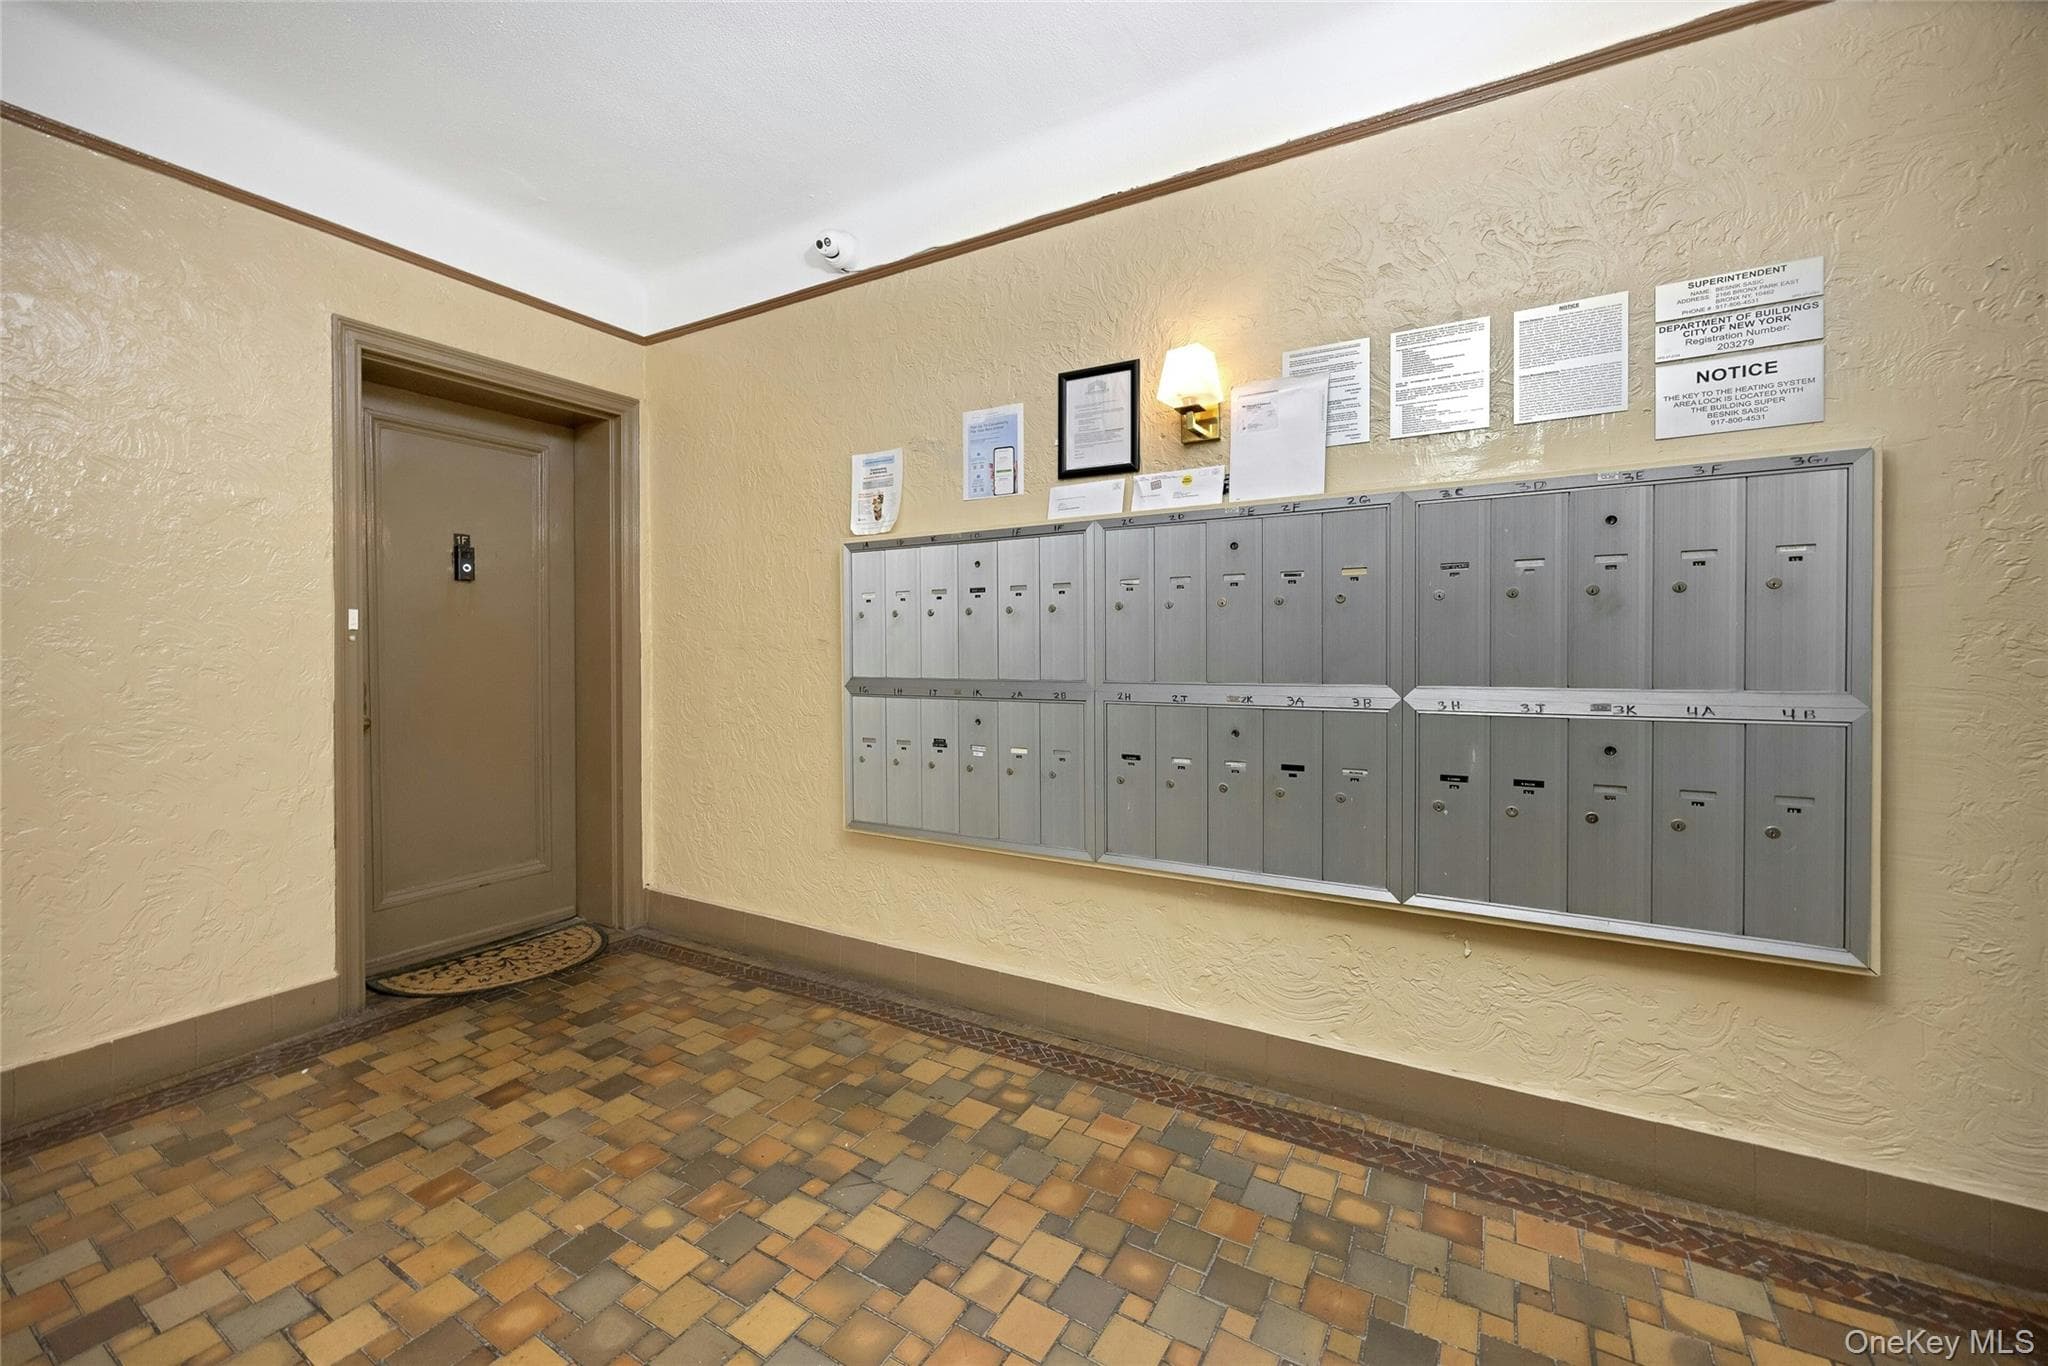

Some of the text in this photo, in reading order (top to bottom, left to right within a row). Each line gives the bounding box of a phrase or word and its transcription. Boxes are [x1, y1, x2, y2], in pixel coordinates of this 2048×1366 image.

[1687, 264, 1788, 290] SUPERINTENDENT
[1676, 294, 1709, 305] ADDRESS
[1732, 286, 1757, 295] BRONX
[1759, 282, 1778, 290] PARK
[1780, 278, 1799, 287] EAST
[1690, 279, 1764, 297] NAME BESNIK SASIC
[1715, 295, 1740, 304] BRONX
[1658, 301, 1819, 334] DEPARTMENT OF BUILDINGS
[1681, 307, 1705, 316] PHONE
[1682, 314, 1792, 338] CITY OF NEW YORK
[1685, 324, 1790, 347] Registration Number:
[1717, 338, 1755, 351] 203279
[1696, 360, 1779, 384] NOTICE
[1663, 376, 1816, 402] THE KEY TO THE HEATING SYSTEM
[1673, 385, 1804, 408] AREA LOCK IS LOCATED WITH
[1691, 396, 1786, 414] THE BUILDING SUPER
[1707, 406, 1769, 419] BESNIK SASIC
[1692, 463, 1723, 476] 3F
[1622, 470, 1645, 482] 3E
[1439, 487, 1464, 498] 3C
[1346, 494, 1371, 505] 2G
[1281, 502, 1301, 513] 2F
[1121, 518, 1134, 526] 2C
[456, 535, 469, 545] 1F
[1011, 691, 1023, 699] 2A
[1053, 691, 1067, 700] 2B
[1117, 692, 1131, 701] 2H
[1240, 695, 1254, 704] 2K
[1286, 696, 1304, 708] 3A
[1352, 698, 1372, 708] 3B
[1437, 701, 1462, 711] 3H
[1613, 705, 1638, 716] 3K
[1686, 706, 1716, 718] 4A
[1783, 708, 1816, 721] 4B
